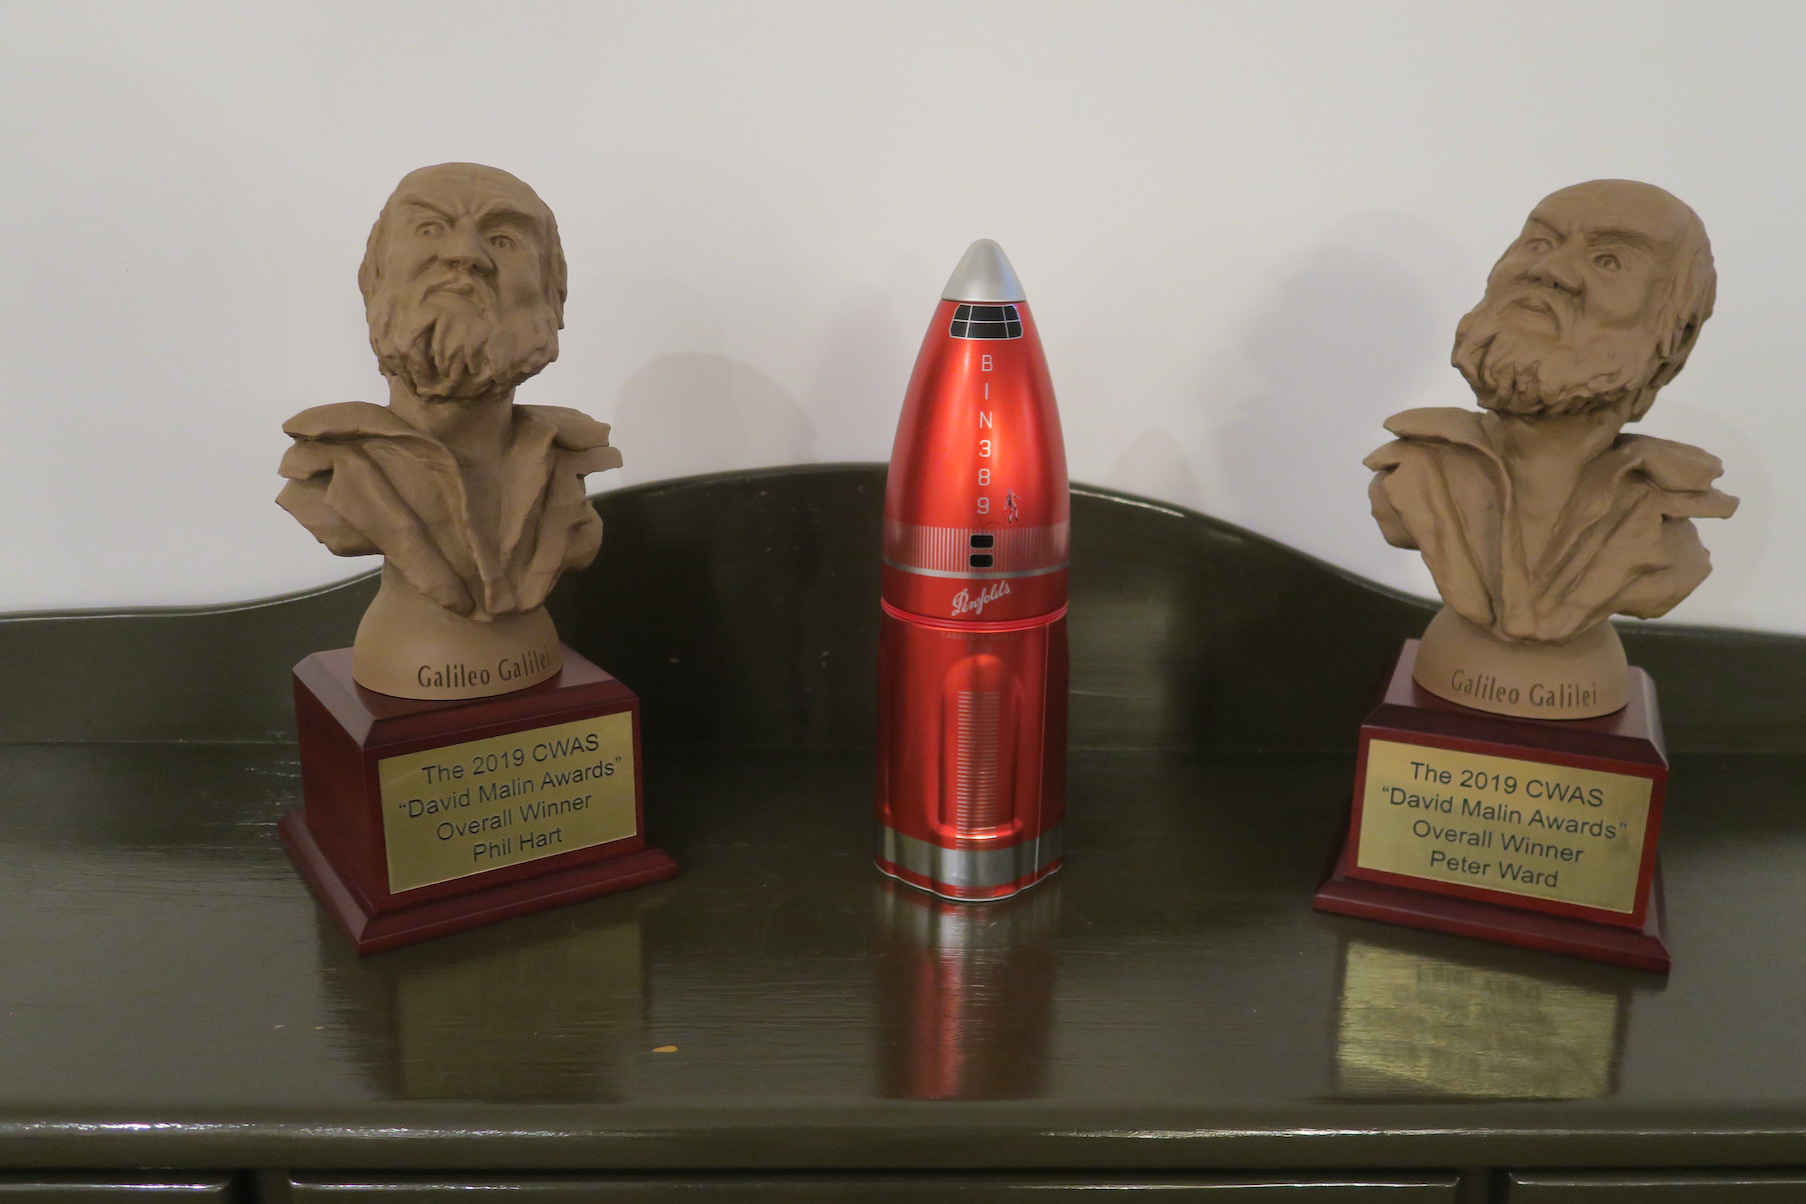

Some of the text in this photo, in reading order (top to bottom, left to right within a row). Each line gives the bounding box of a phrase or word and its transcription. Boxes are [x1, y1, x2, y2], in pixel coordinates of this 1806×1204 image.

[951, 580, 1011, 616] Penfolds
[417, 645, 551, 688] Galileo Galilei
[1451, 668, 1597, 708] Galileo Galilei
[421, 733, 599, 784] The 2019 CWAS
[479, 778, 534, 804] Malin
[1410, 762, 1604, 807] The 2019 CWAS
[437, 793, 593, 841] Overall Winner
[1461, 798, 1522, 825] Malin
[473, 827, 563, 863] Phil Hart
[1413, 819, 1584, 863] Overall Winner
[1430, 851, 1559, 888] Peter Ward
